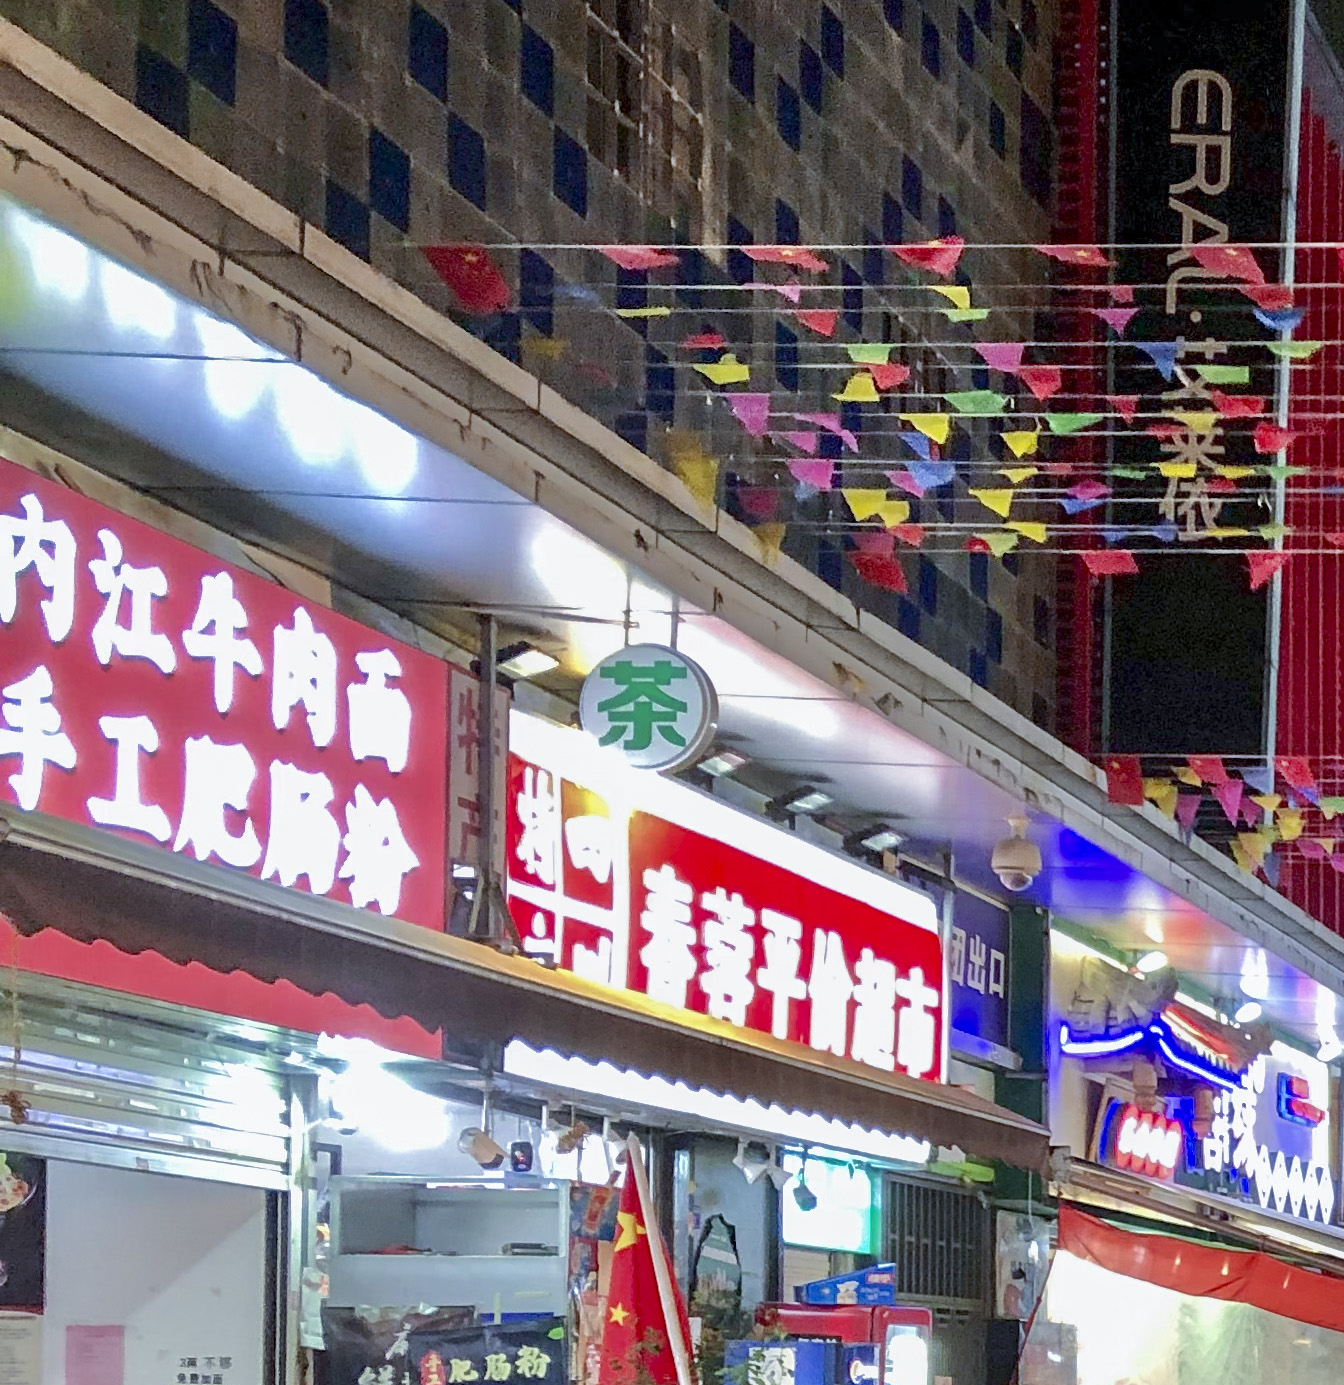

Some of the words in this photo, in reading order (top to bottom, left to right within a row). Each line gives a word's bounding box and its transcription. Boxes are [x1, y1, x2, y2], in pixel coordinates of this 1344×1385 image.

[0, 493, 412, 773] 内江牛肉面
[597, 660, 688, 751] 茶
[0, 665, 419, 916] 手工肥肠粉
[450, 1345, 551, 1383] 肥肠粉
